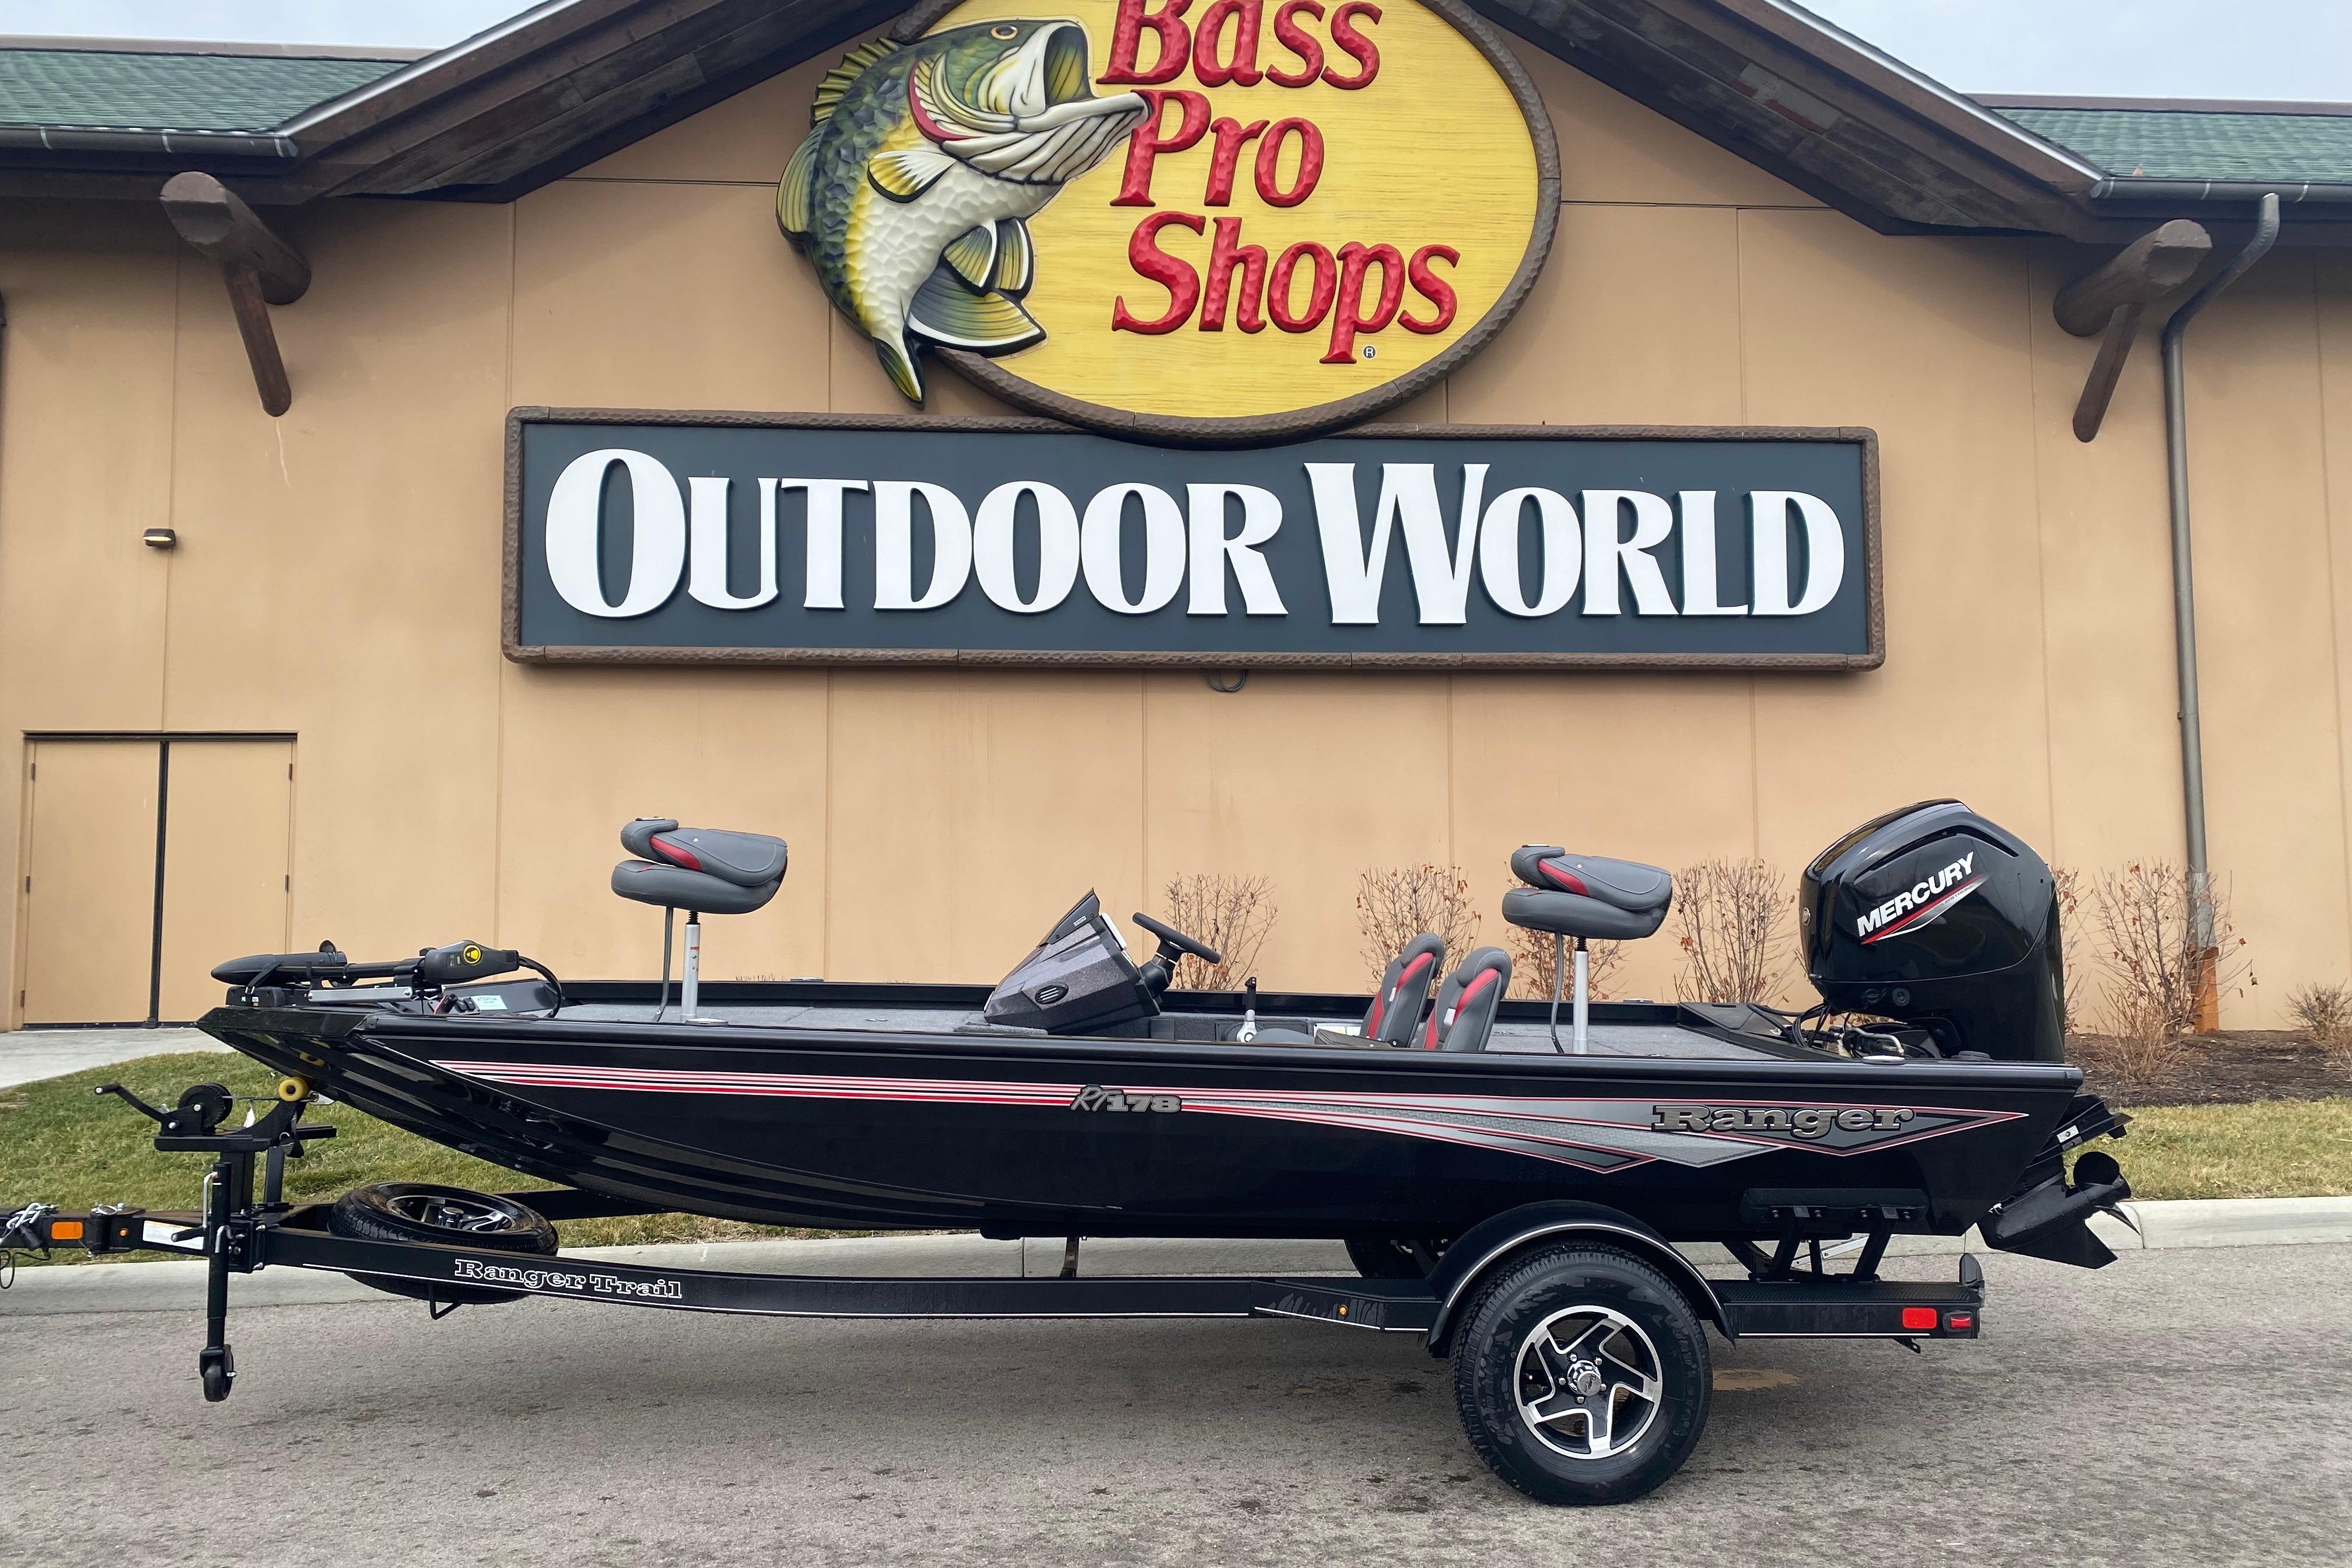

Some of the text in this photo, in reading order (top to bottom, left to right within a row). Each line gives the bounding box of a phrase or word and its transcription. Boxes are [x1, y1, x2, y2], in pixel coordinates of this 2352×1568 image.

[1096, 0, 1382, 90] Bass
[1110, 89, 1325, 208] Pro
[1112, 211, 1460, 364] Shops
[545, 448, 1845, 625] OUTDOOR WORLD
[1857, 851, 1974, 937] MERCURY
[1652, 1105, 1916, 1139] Ranger
[454, 1258, 682, 1299] Ranger Trail
